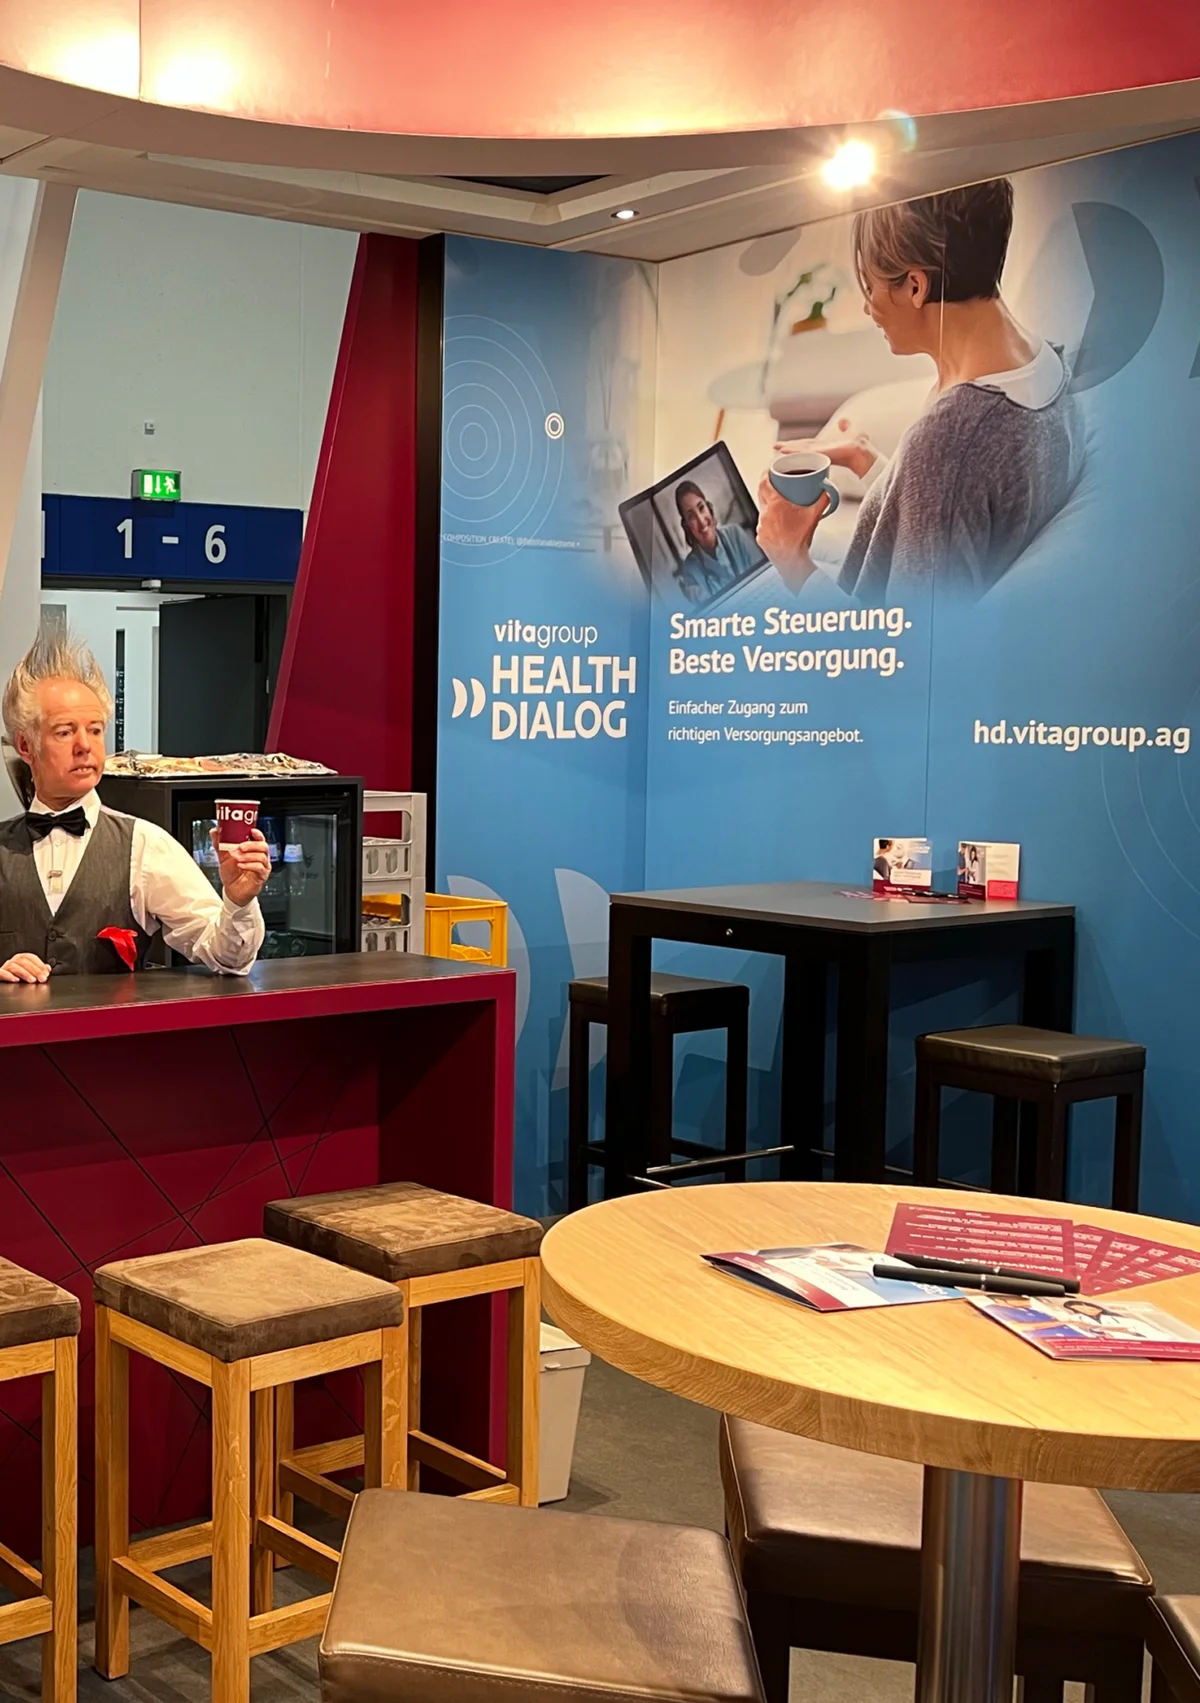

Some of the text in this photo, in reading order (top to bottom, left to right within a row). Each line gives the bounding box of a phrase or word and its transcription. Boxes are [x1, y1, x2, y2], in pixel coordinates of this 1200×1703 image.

[116, 518, 133, 559] 1
[204, 524, 227, 564] 6
[494, 619, 598, 648] vitagroup
[669, 607, 913, 640] Smarte Steuerung.
[492, 655, 637, 694] HEALTH
[669, 645, 905, 678] Beste Versorgung.
[492, 700, 627, 740] DIALOG
[668, 700, 808, 718] Einfacher Zugang zum
[668, 726, 864, 746] richtigen Versorgungsangebot.
[973, 719, 1191, 754] hd.vitagroup.ag
